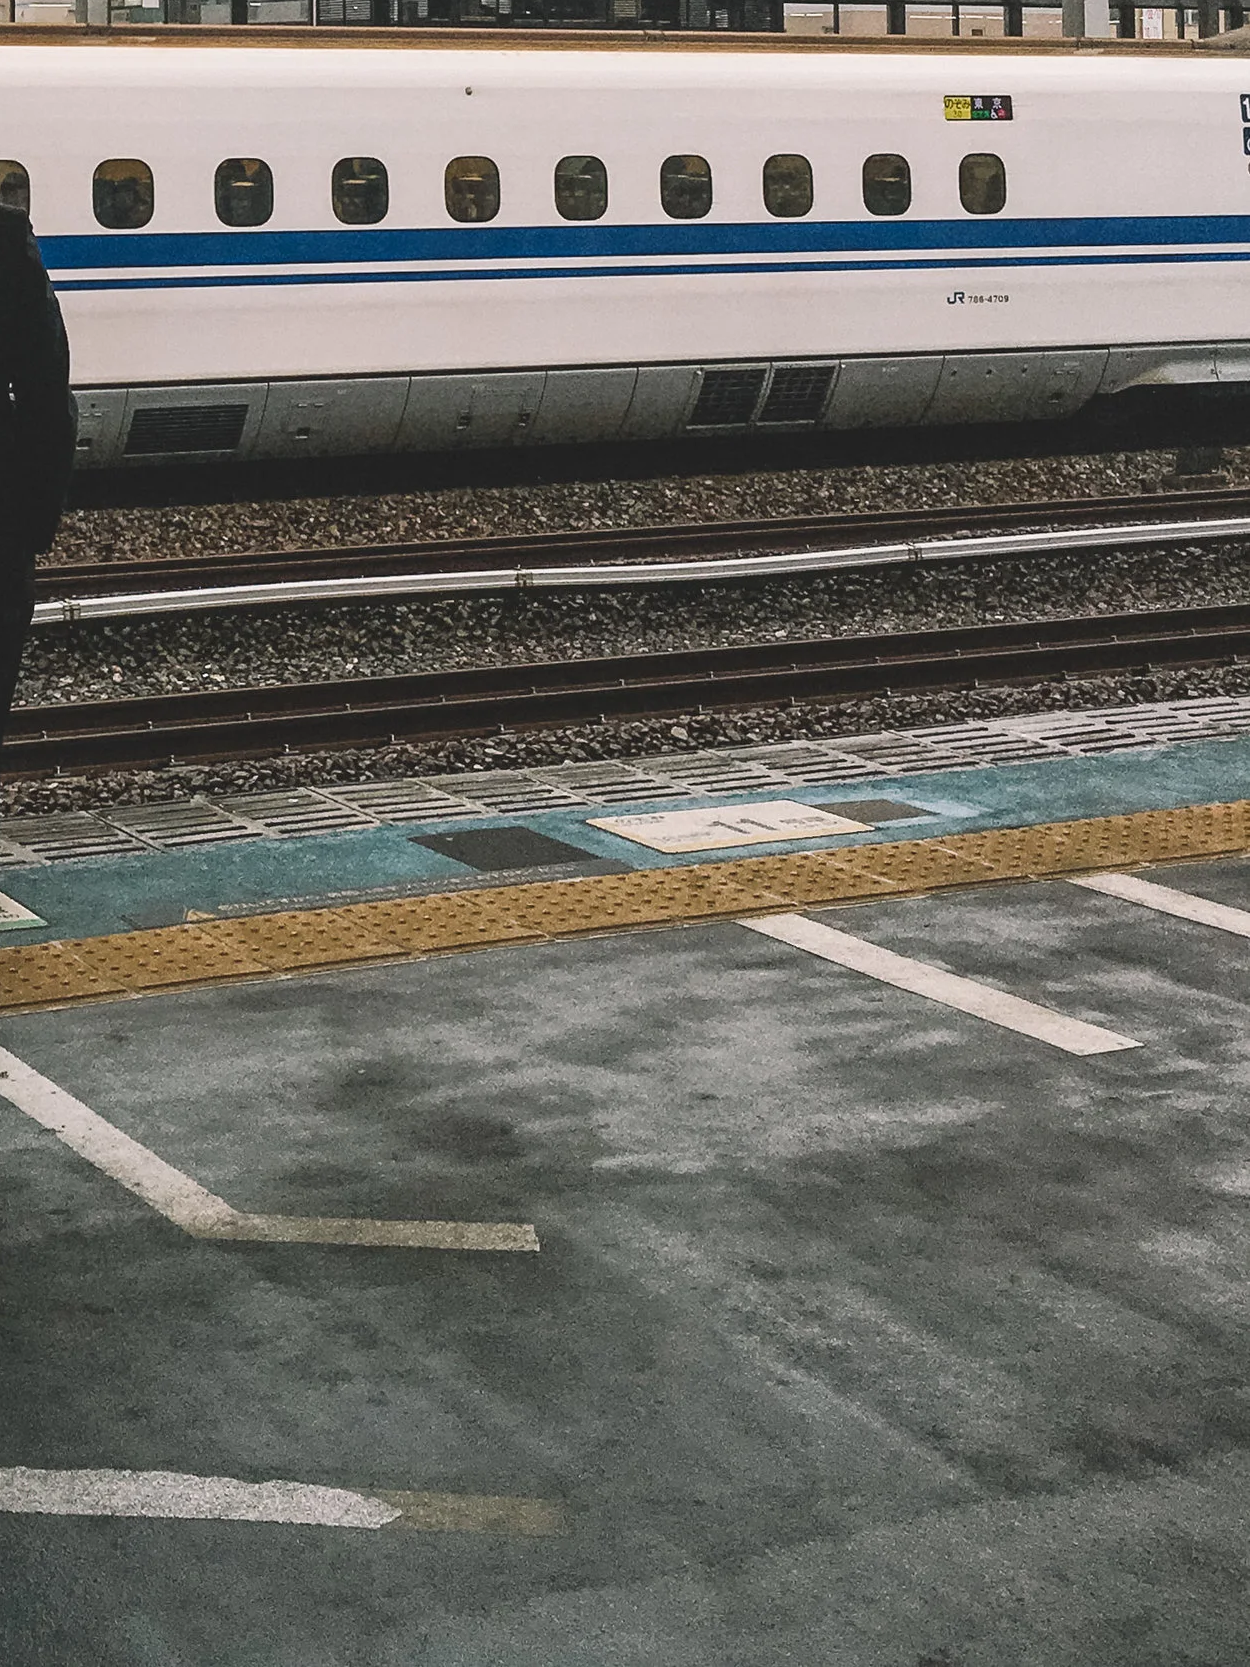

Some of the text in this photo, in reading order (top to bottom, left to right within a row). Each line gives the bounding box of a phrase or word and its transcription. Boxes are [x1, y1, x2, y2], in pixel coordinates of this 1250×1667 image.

[944, 98, 970, 110] のぞみ
[946, 291, 966, 304] JR
